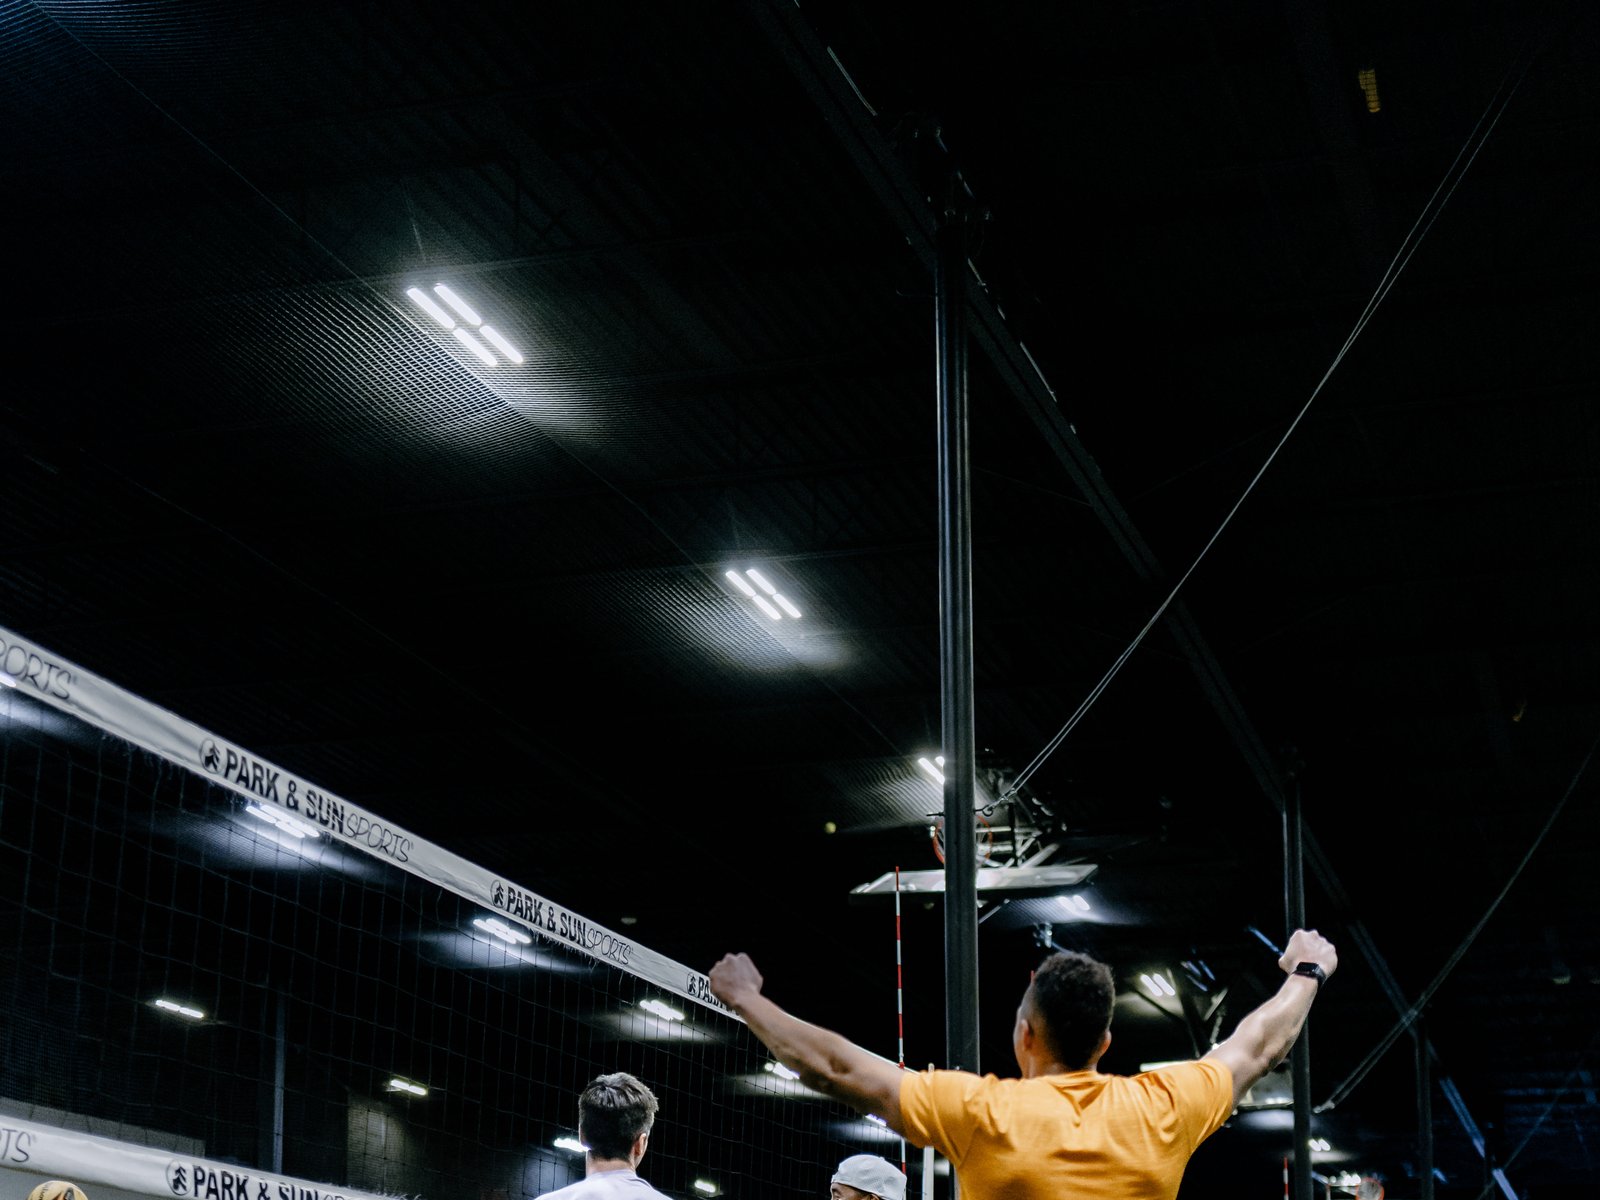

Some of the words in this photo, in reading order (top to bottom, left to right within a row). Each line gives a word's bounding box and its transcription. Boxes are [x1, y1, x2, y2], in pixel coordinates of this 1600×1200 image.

[224, 748, 279, 803] PARK
[286, 780, 299, 811] &
[506, 886, 543, 927] PARK
[547, 906, 556, 932] &
[0, 1127, 31, 1163] TS
